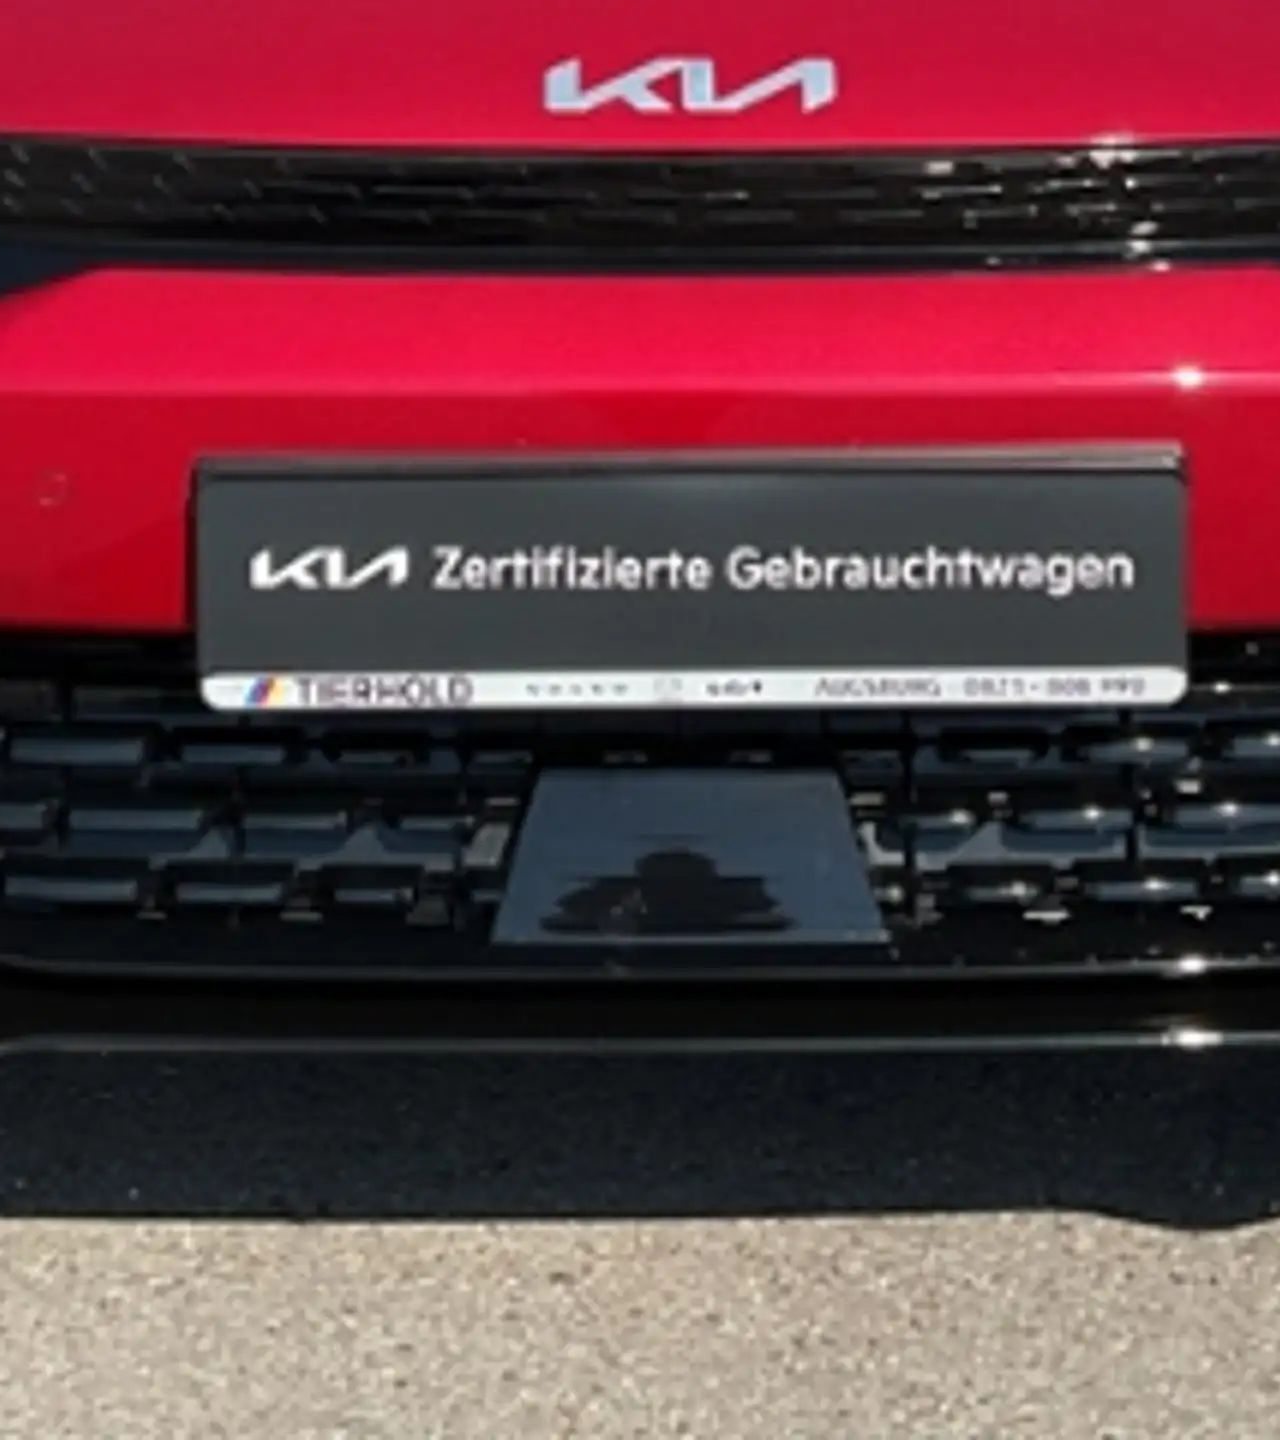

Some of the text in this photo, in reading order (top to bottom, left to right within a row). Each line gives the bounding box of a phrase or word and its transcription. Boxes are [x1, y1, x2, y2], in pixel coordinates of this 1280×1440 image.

[544, 57, 837, 113] KIA
[250, 545, 1135, 597] KIA Zertifizierte Gebrauchtwagen
[298, 675, 474, 707] TIERHOLD
